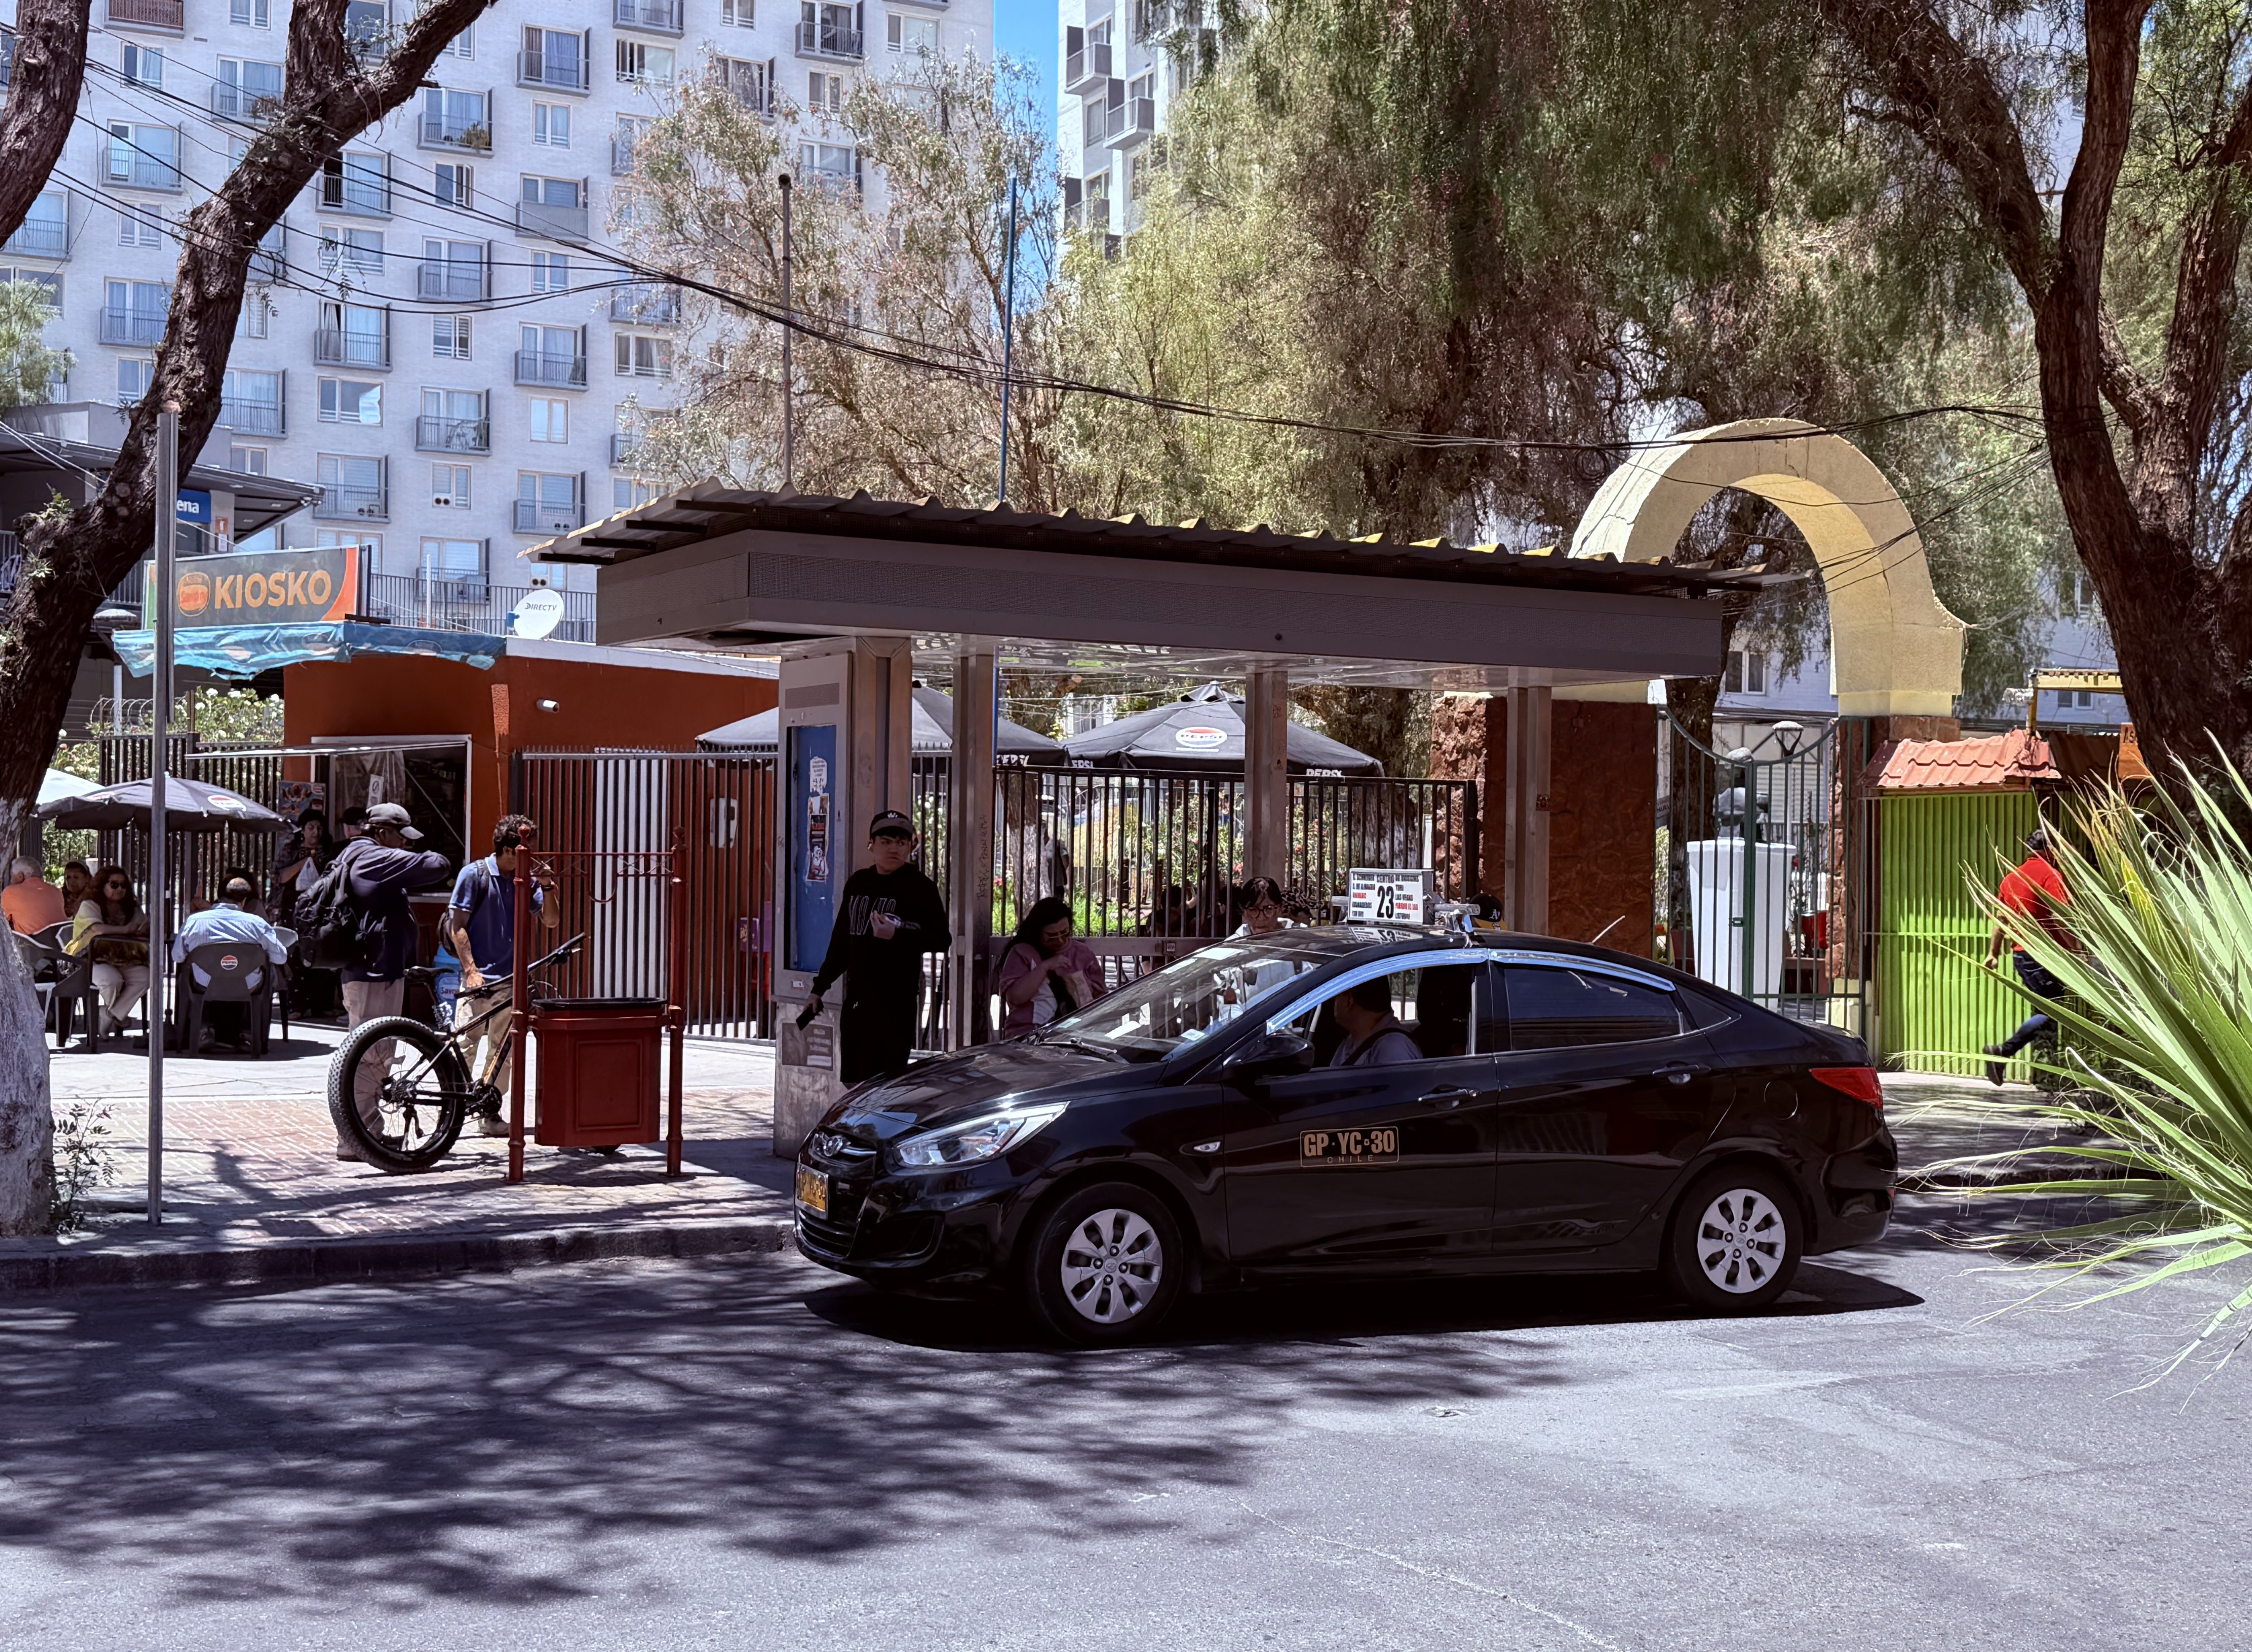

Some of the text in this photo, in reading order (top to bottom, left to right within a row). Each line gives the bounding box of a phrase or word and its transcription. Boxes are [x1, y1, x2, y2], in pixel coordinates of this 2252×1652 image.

[176, 500, 199, 514] ena
[214, 569, 332, 609] KIOSKO
[525, 602, 557, 611] DIRECTV
[1377, 885, 1394, 919] 23
[1327, 1154, 1373, 1164] CHILE
